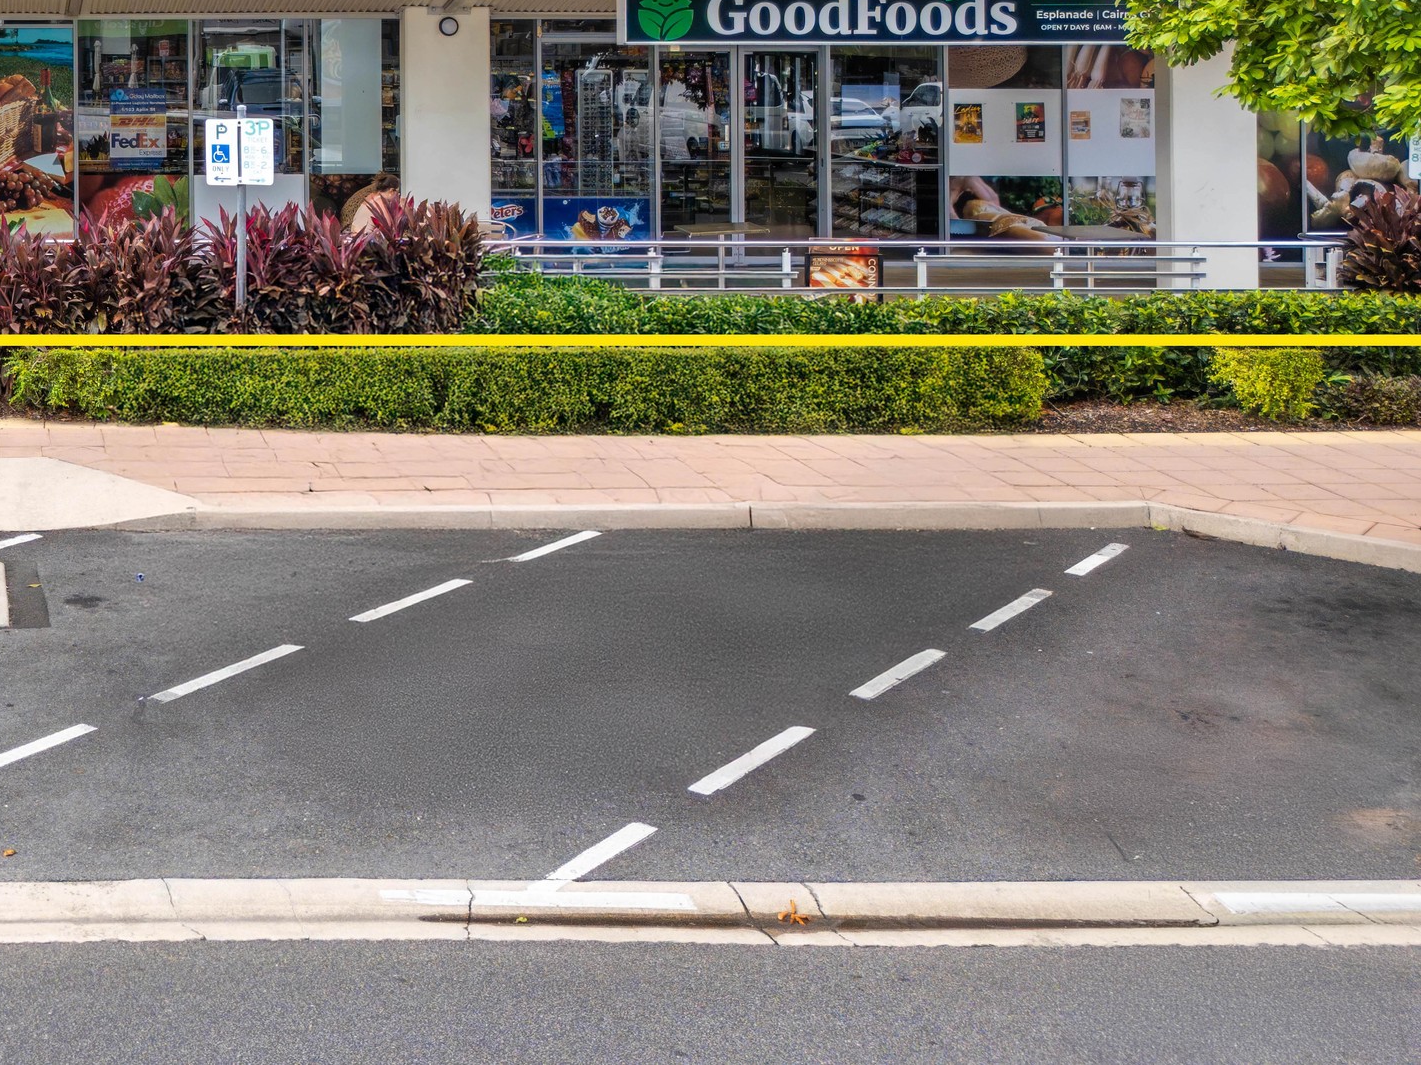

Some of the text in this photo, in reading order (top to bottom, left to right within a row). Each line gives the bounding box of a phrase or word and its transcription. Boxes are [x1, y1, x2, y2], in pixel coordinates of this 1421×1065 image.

[1036, 10, 1094, 21] Esplanade
[1093, 24, 1112, 32] (6AM
[118, 117, 157, 126] DHL
[244, 120, 270, 135] 3P
[216, 124, 228, 140] P
[111, 133, 160, 149] FedEx
